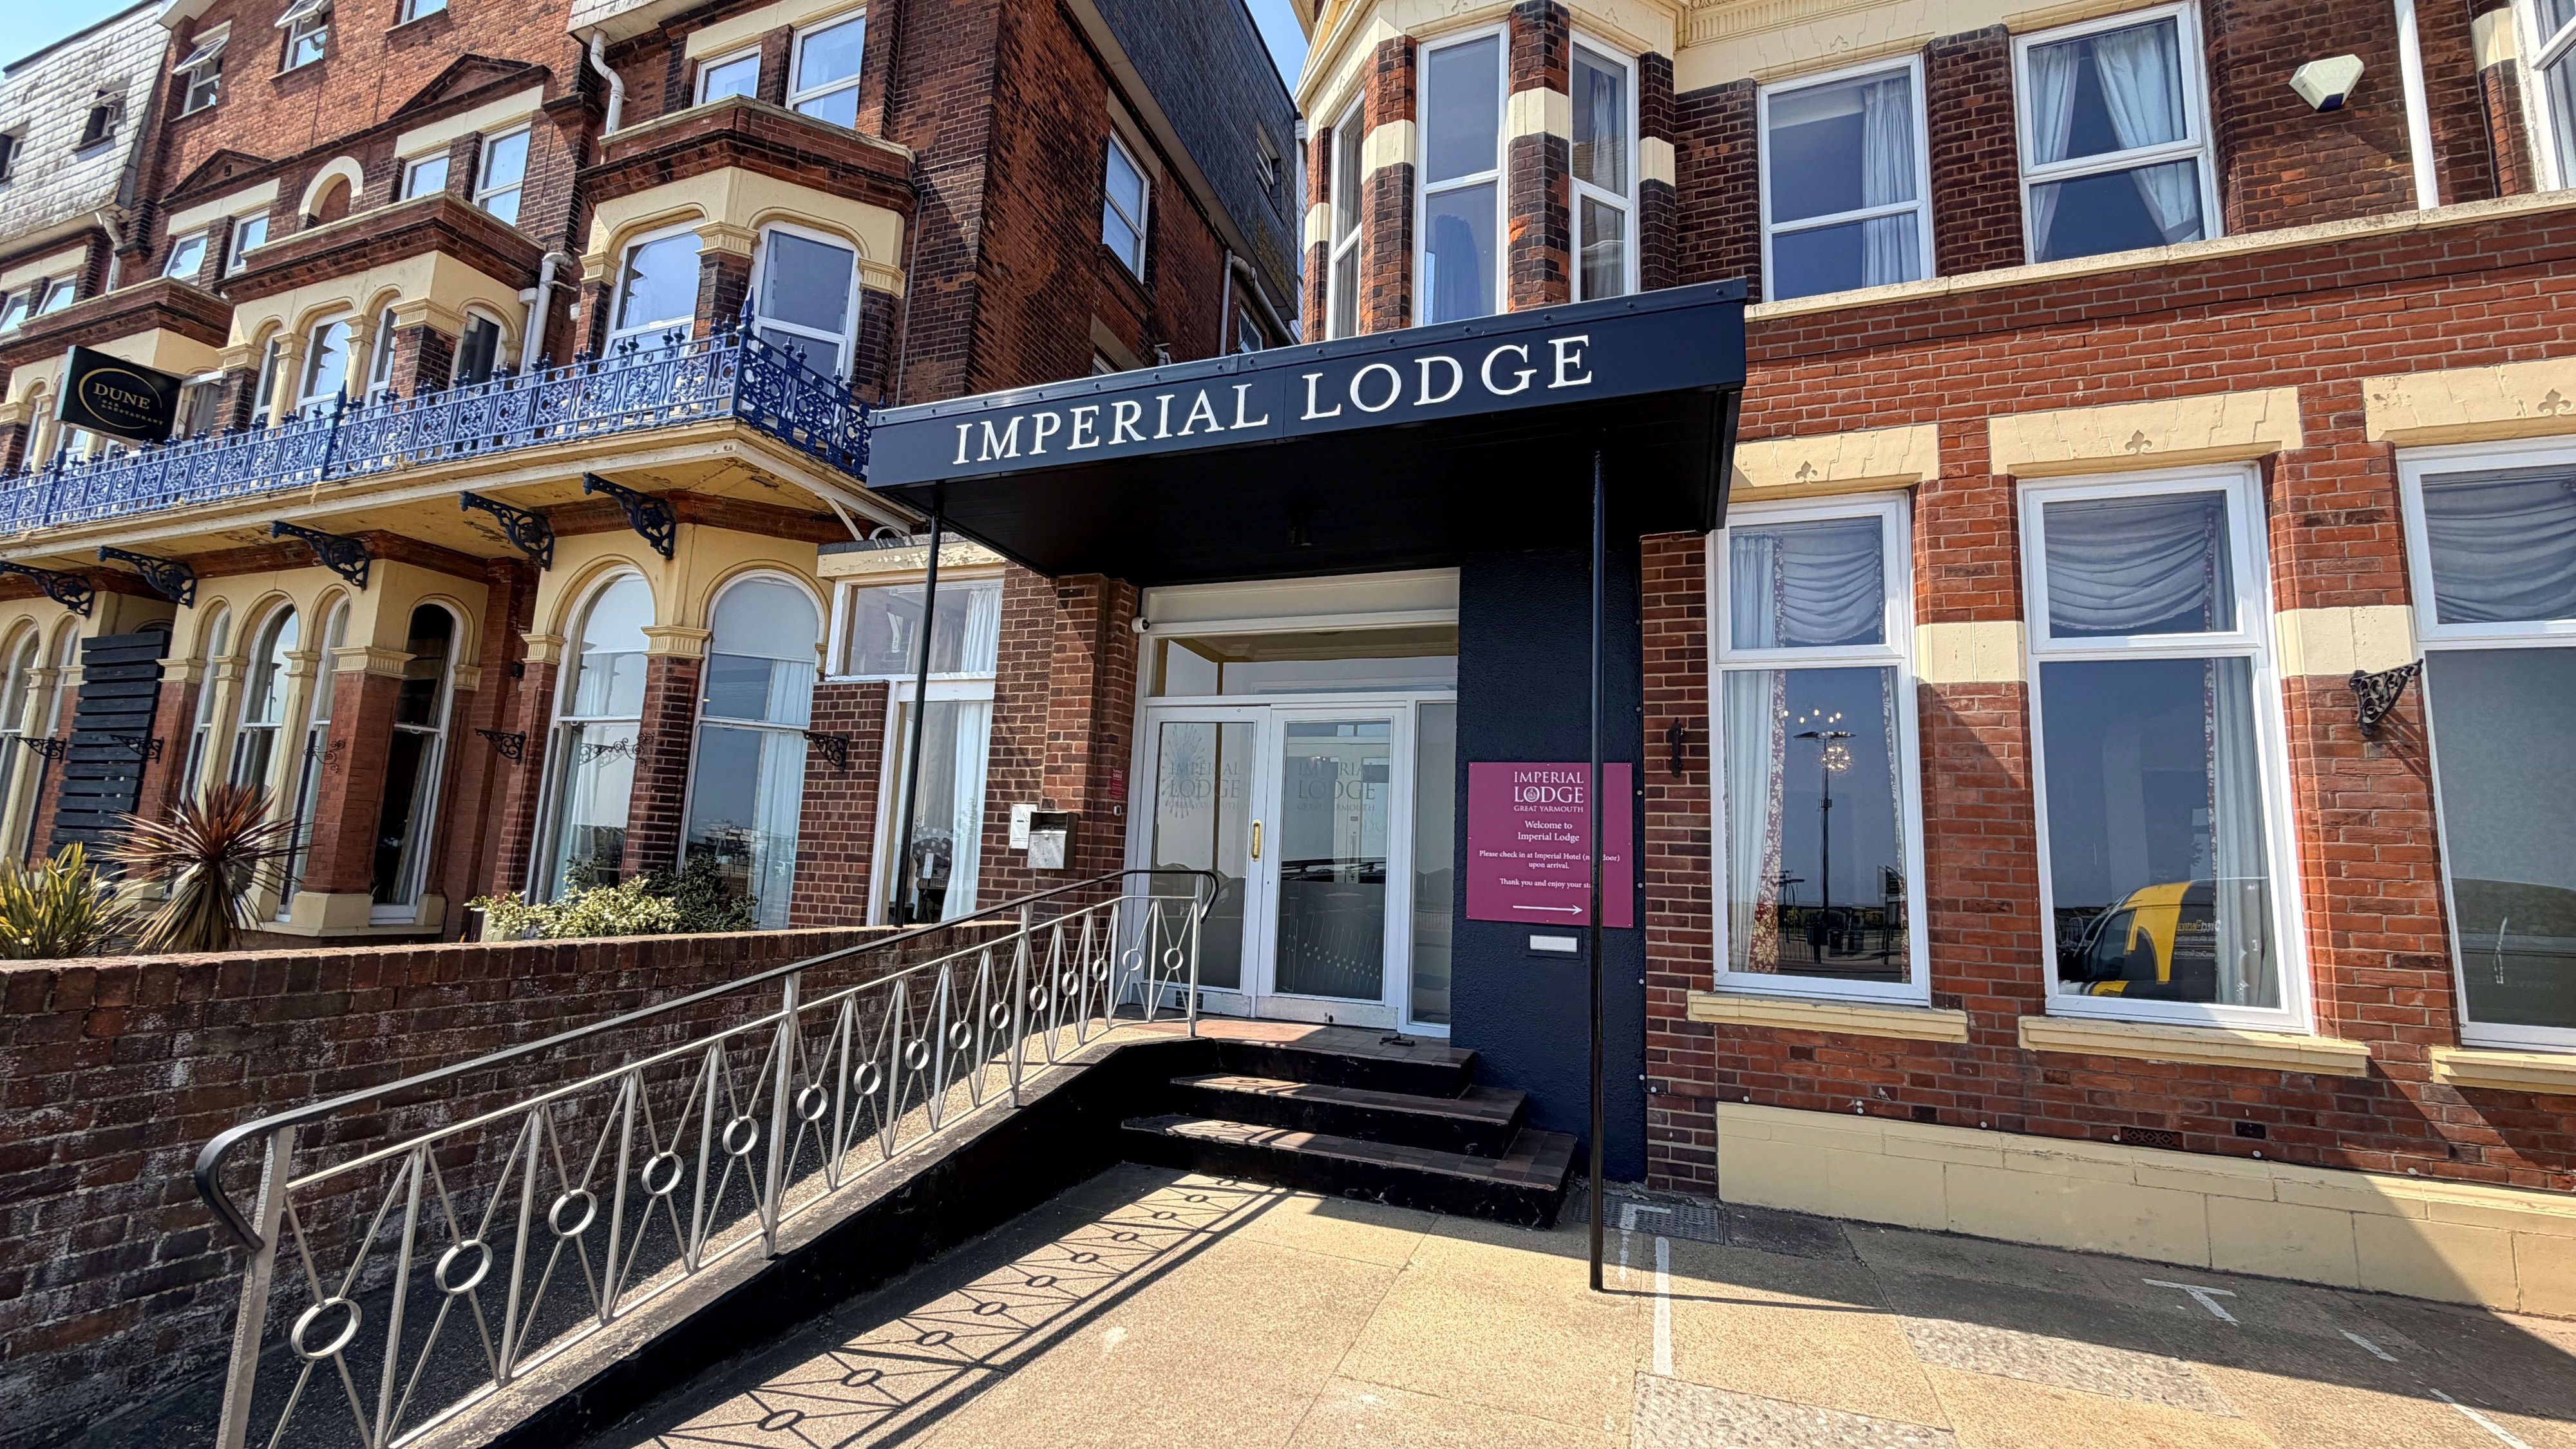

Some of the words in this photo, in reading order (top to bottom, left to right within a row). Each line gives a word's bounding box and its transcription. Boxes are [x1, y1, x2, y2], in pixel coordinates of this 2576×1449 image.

[93, 383, 150, 410] DUNE
[952, 383, 1269, 466] IMPERIAL
[1300, 335, 1593, 421] LODGE
[102, 399, 119, 408] BAR
[1514, 772, 1584, 784] IMPERIAL
[1514, 786, 1584, 804] LODGE
[1525, 820, 1562, 829] Welcome
[1518, 832, 1552, 843] Imperial
[1554, 833, 1580, 844] Lodge
[1534, 852, 1562, 861] Imperial
[1499, 878, 1520, 886] Thank
[1548, 880, 1566, 889] enjoy
